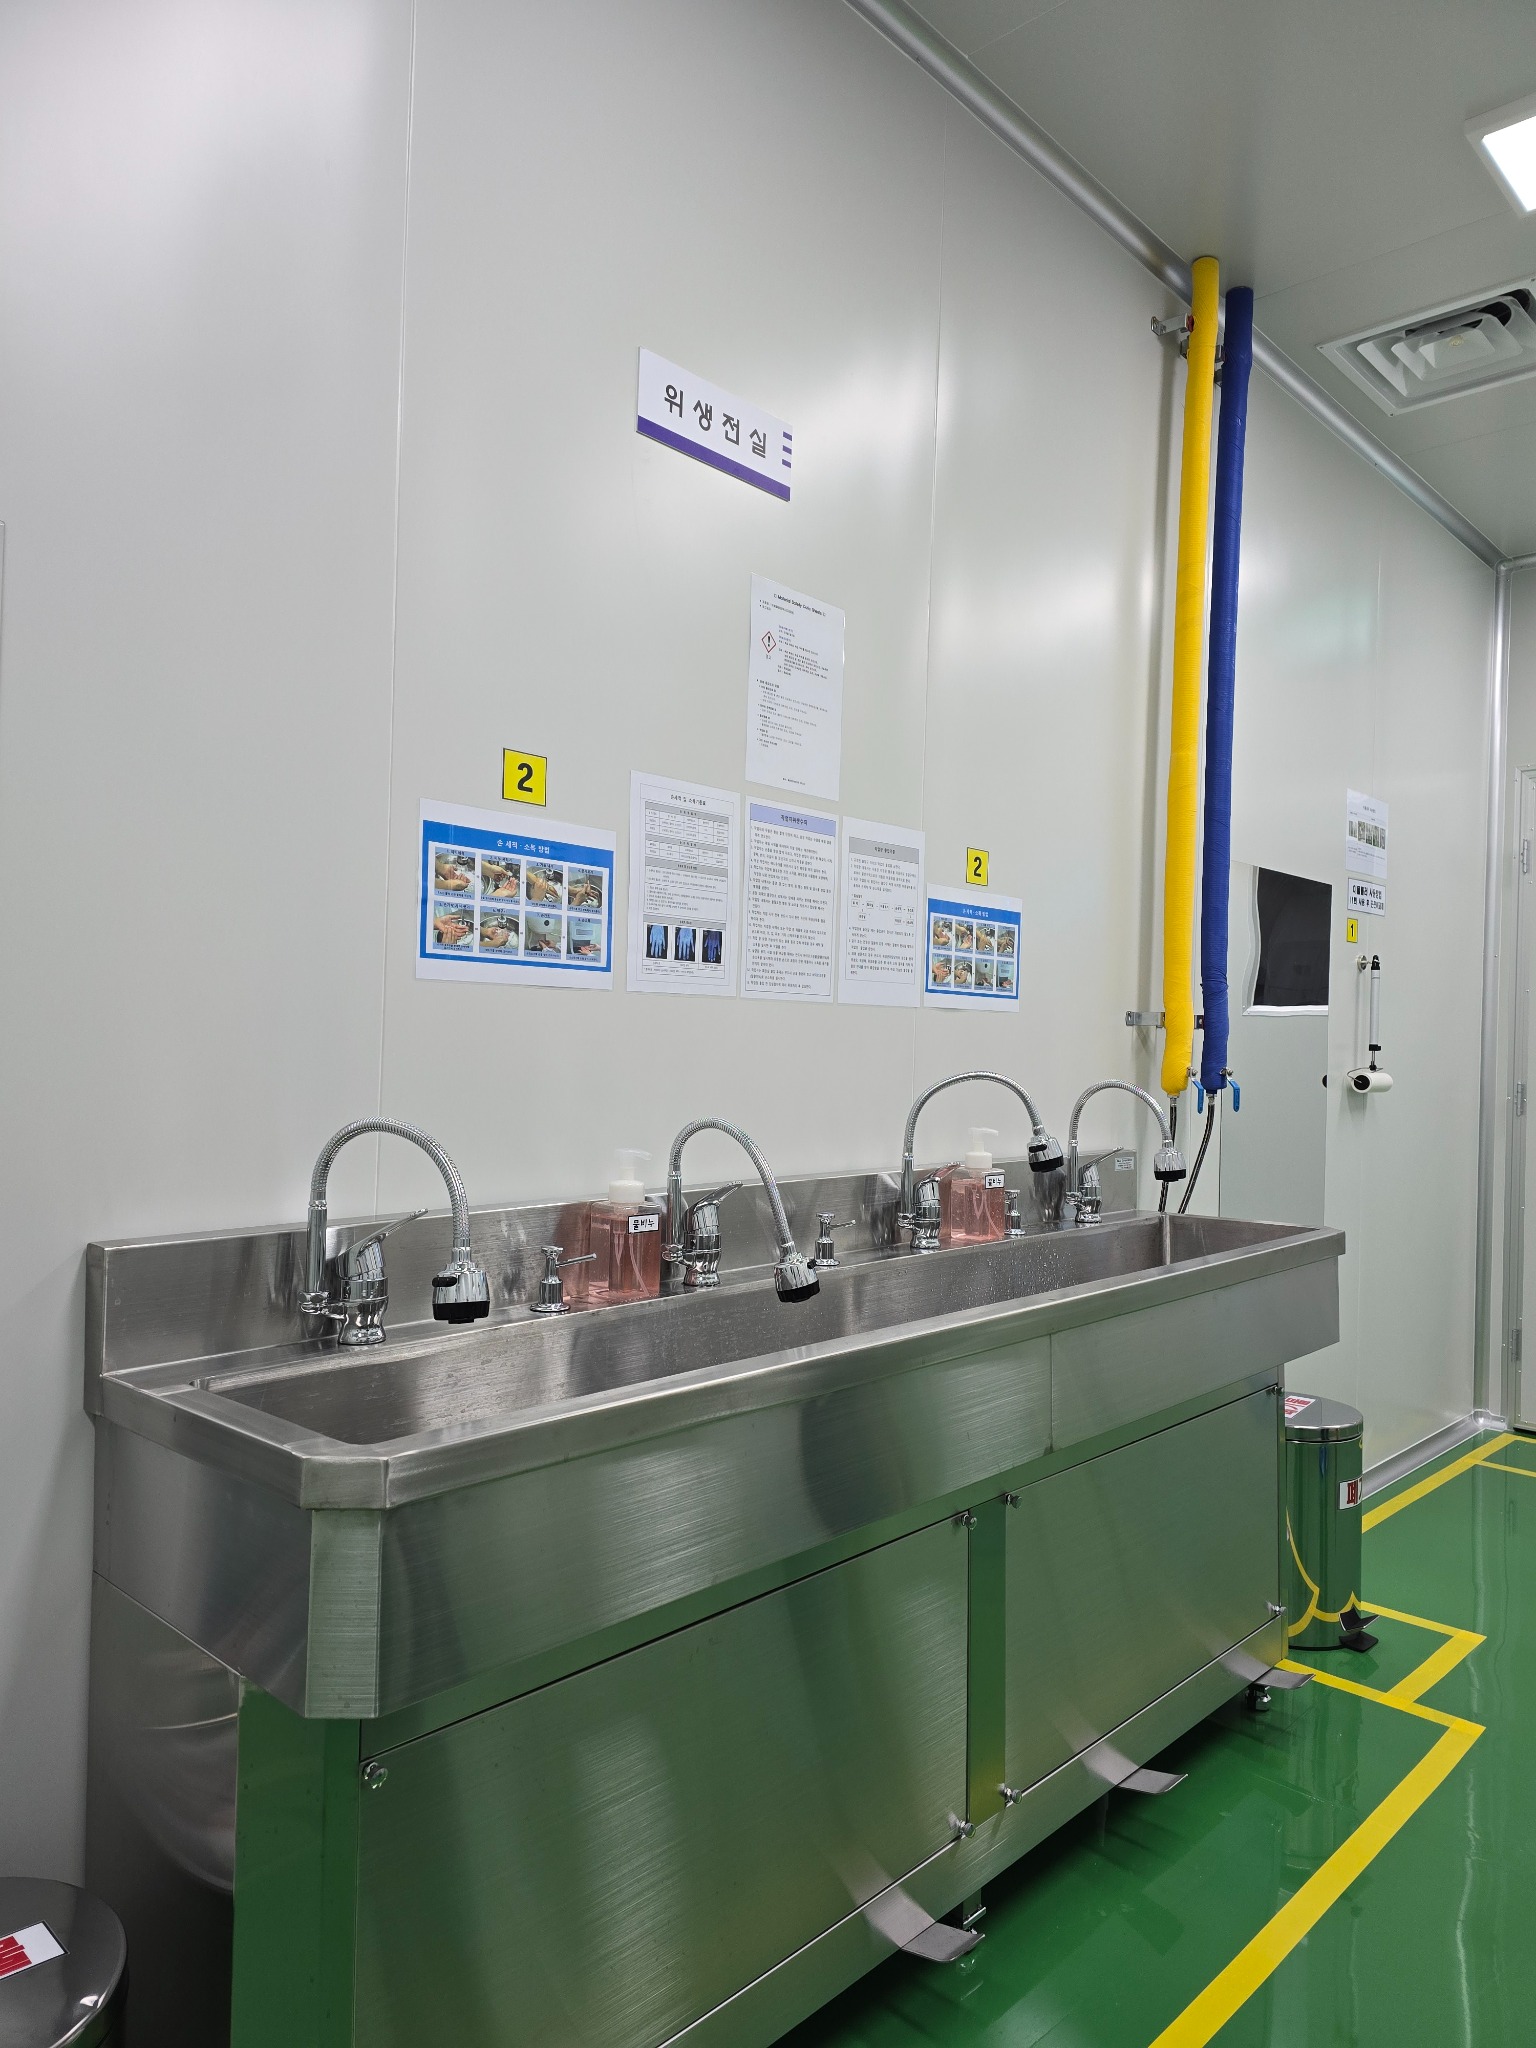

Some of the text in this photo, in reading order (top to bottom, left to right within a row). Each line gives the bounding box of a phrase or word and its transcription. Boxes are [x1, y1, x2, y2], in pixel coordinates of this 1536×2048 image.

[664, 384, 767, 459] 위생전실
[517, 762, 534, 793] 2
[496, 839, 550, 855] 손 세척 소독 방법
[973, 856, 983, 878] 2
[1350, 923, 1354, 937] 1
[987, 1177, 1002, 1187] 물비누
[632, 1218, 655, 1231] 물비누
